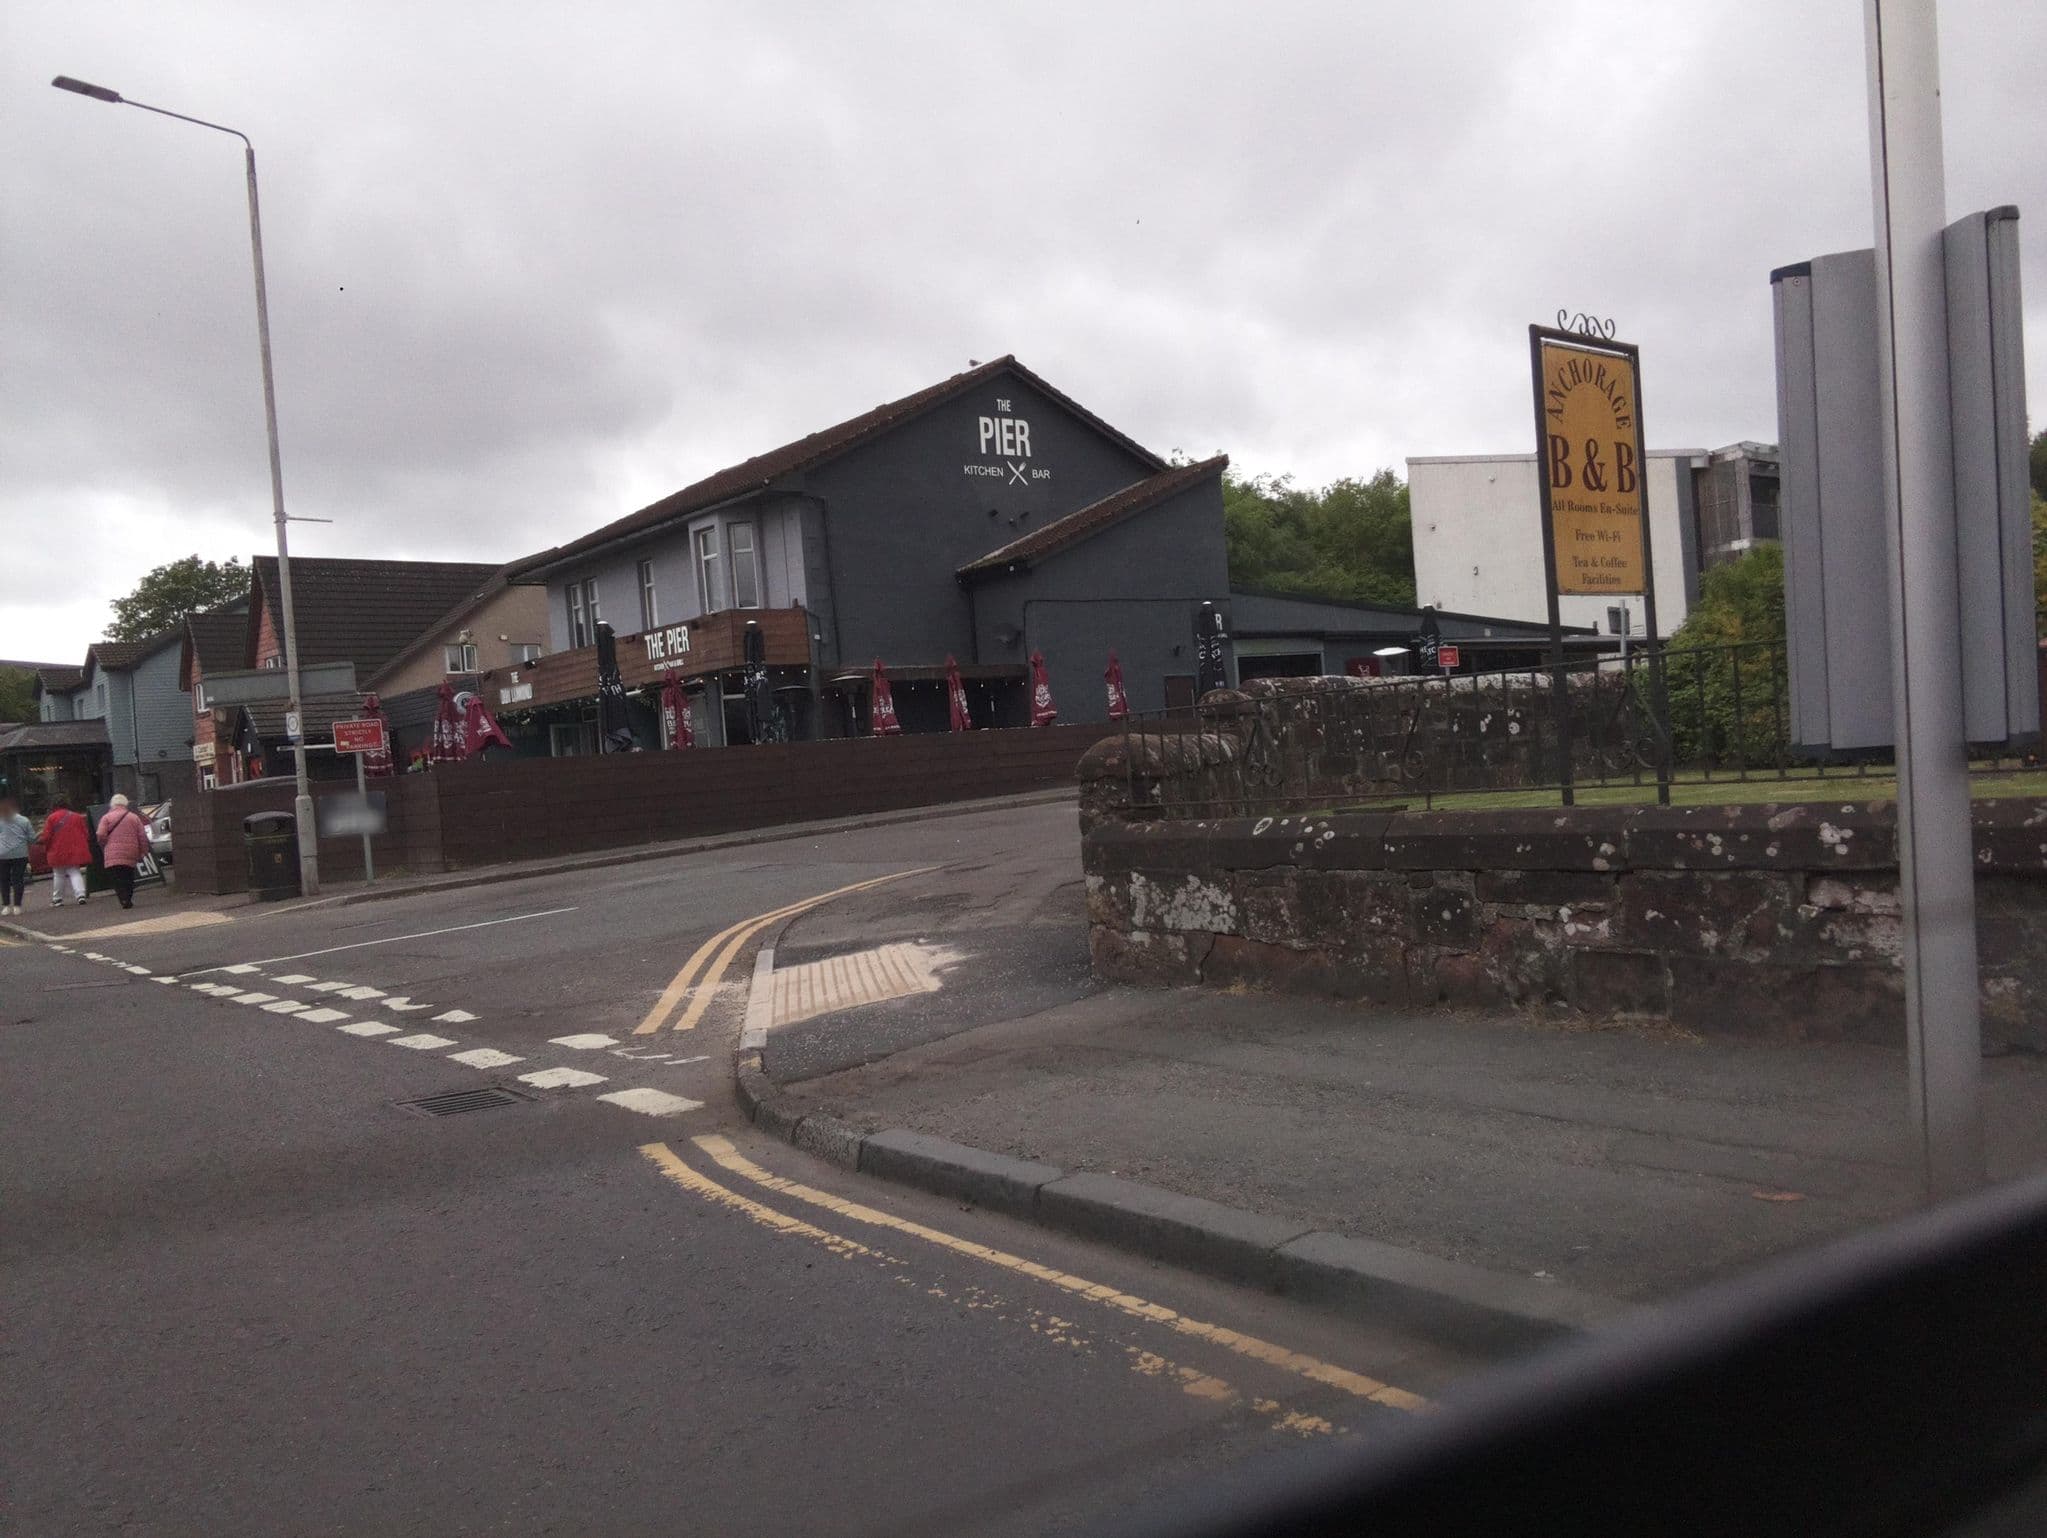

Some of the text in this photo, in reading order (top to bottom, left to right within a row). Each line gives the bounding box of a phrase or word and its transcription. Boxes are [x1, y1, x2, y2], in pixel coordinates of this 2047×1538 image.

[1546, 358, 1632, 430] ANCHORAGE
[996, 399, 1012, 412] THE
[978, 416, 1031, 457] PIER
[963, 465, 1051, 479] KITCHEN BAR
[1552, 500, 1639, 515] All Rooms En-Suite
[1575, 529, 1622, 543] Free Wi-Fi
[1572, 556, 1628, 568] Tea & Coffee
[1582, 573, 1621, 584] Facilities
[644, 625, 690, 660] THE PIER
